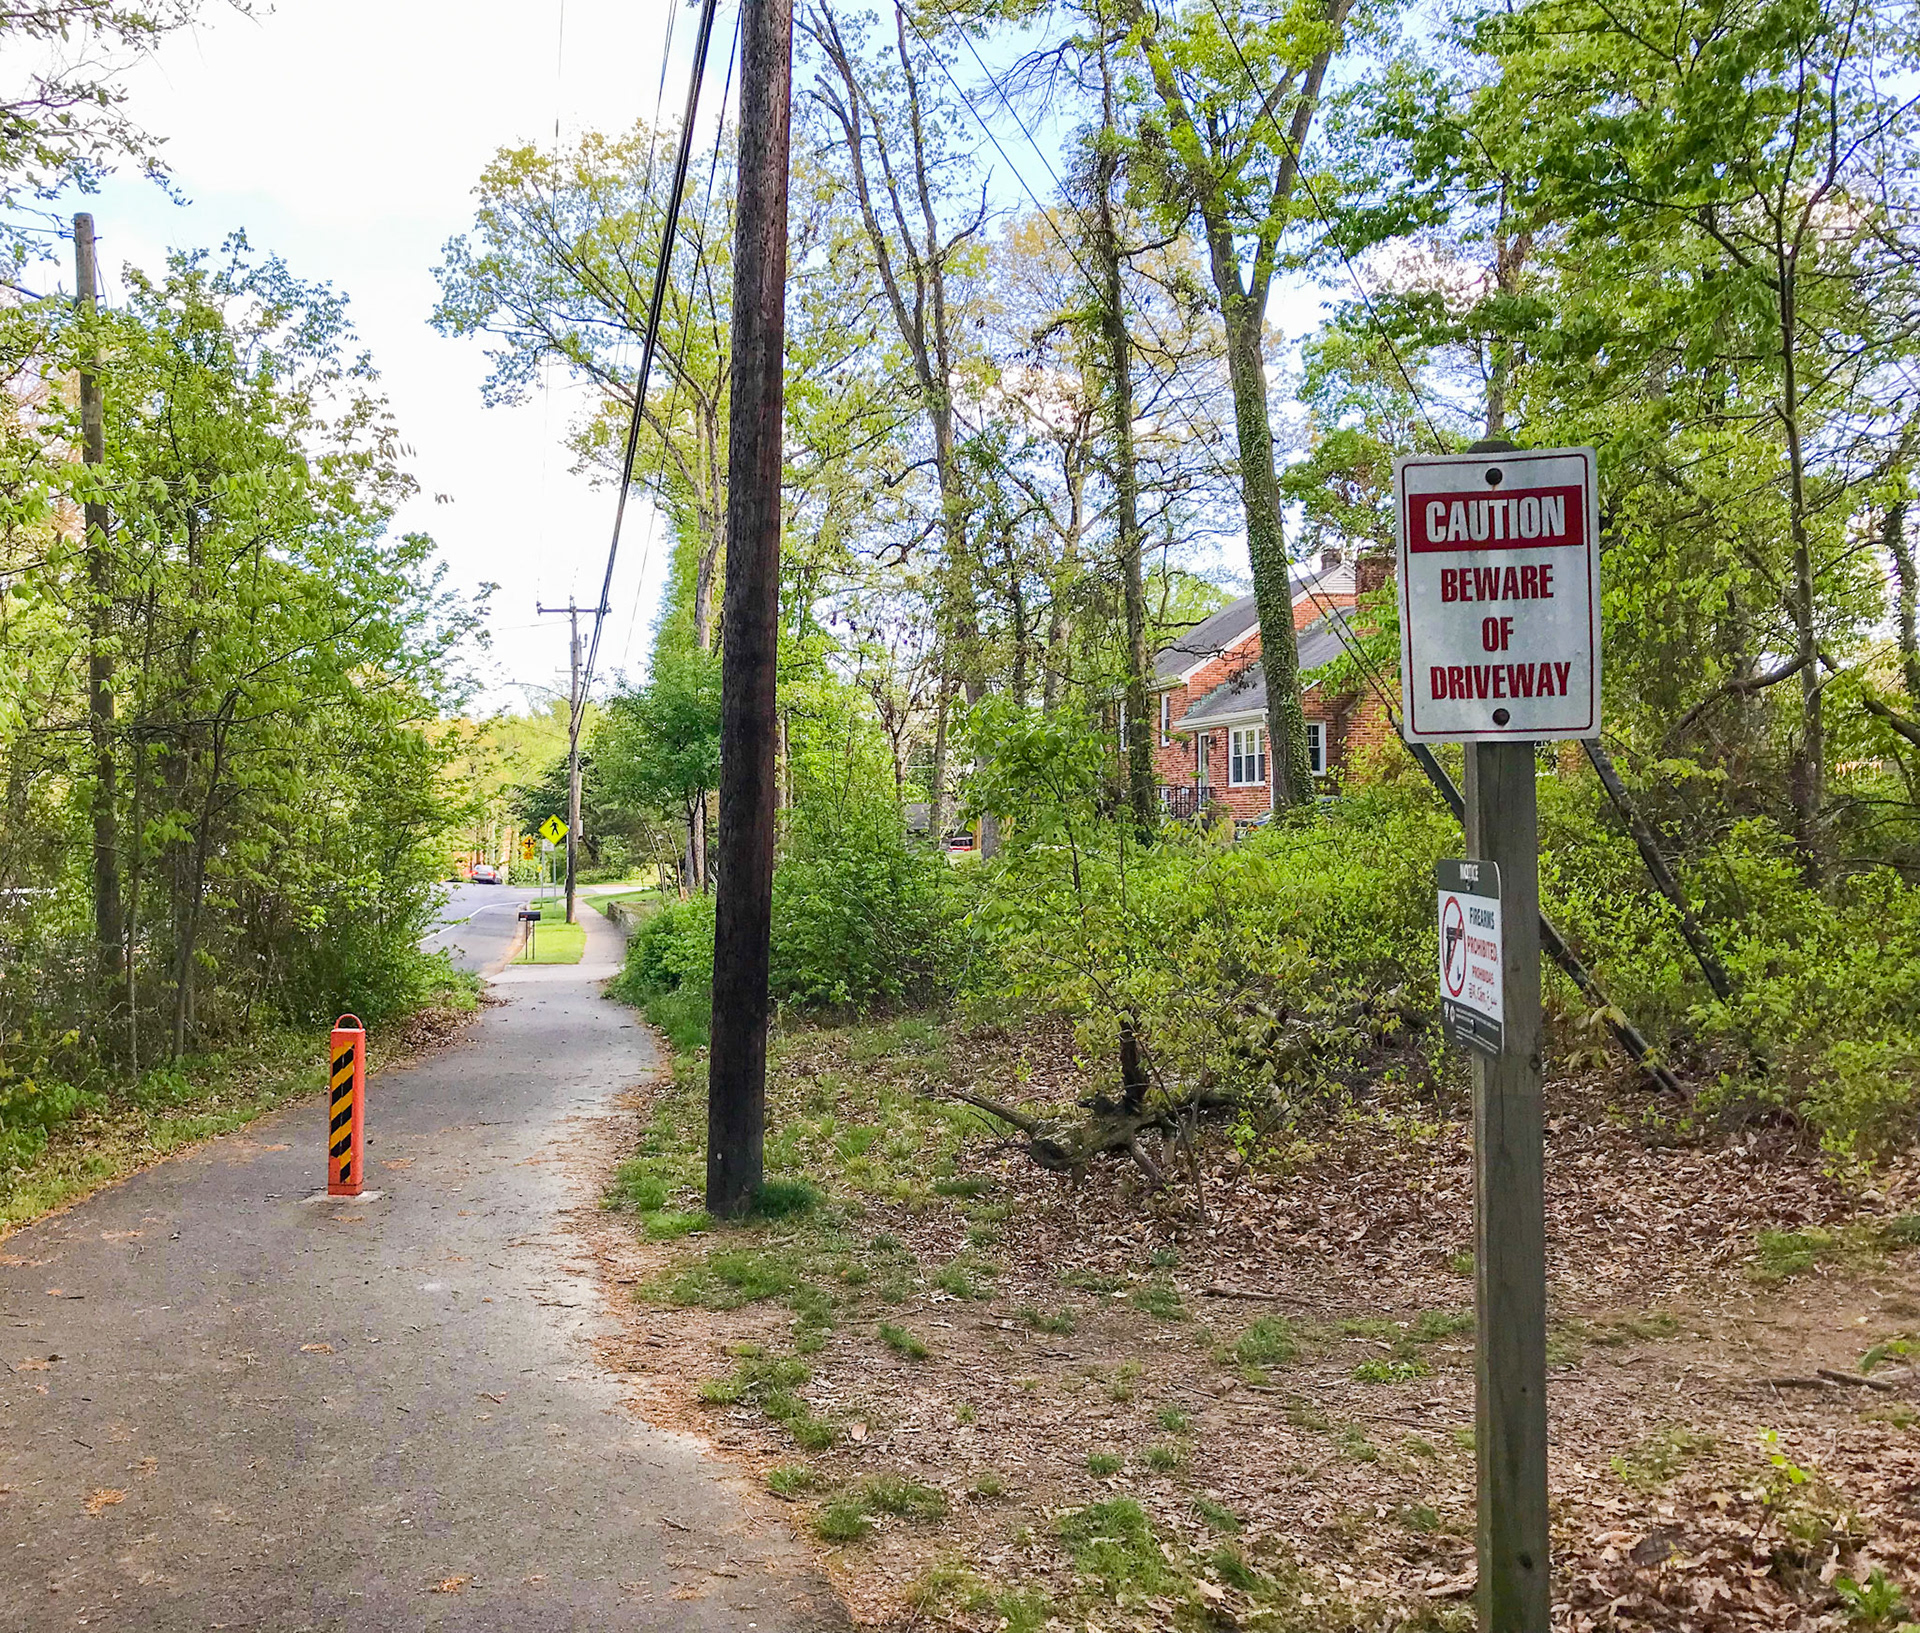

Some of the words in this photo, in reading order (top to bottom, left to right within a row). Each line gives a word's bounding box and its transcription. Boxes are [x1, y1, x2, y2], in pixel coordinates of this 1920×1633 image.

[1426, 495, 1566, 543] CAUTION
[1441, 564, 1553, 602] BEWARE
[1482, 617, 1514, 652] OF
[1430, 661, 1571, 700] DRIVEWAY
[1459, 863, 1479, 881] NOTICE
[1469, 907, 1494, 930] FIREARMS
